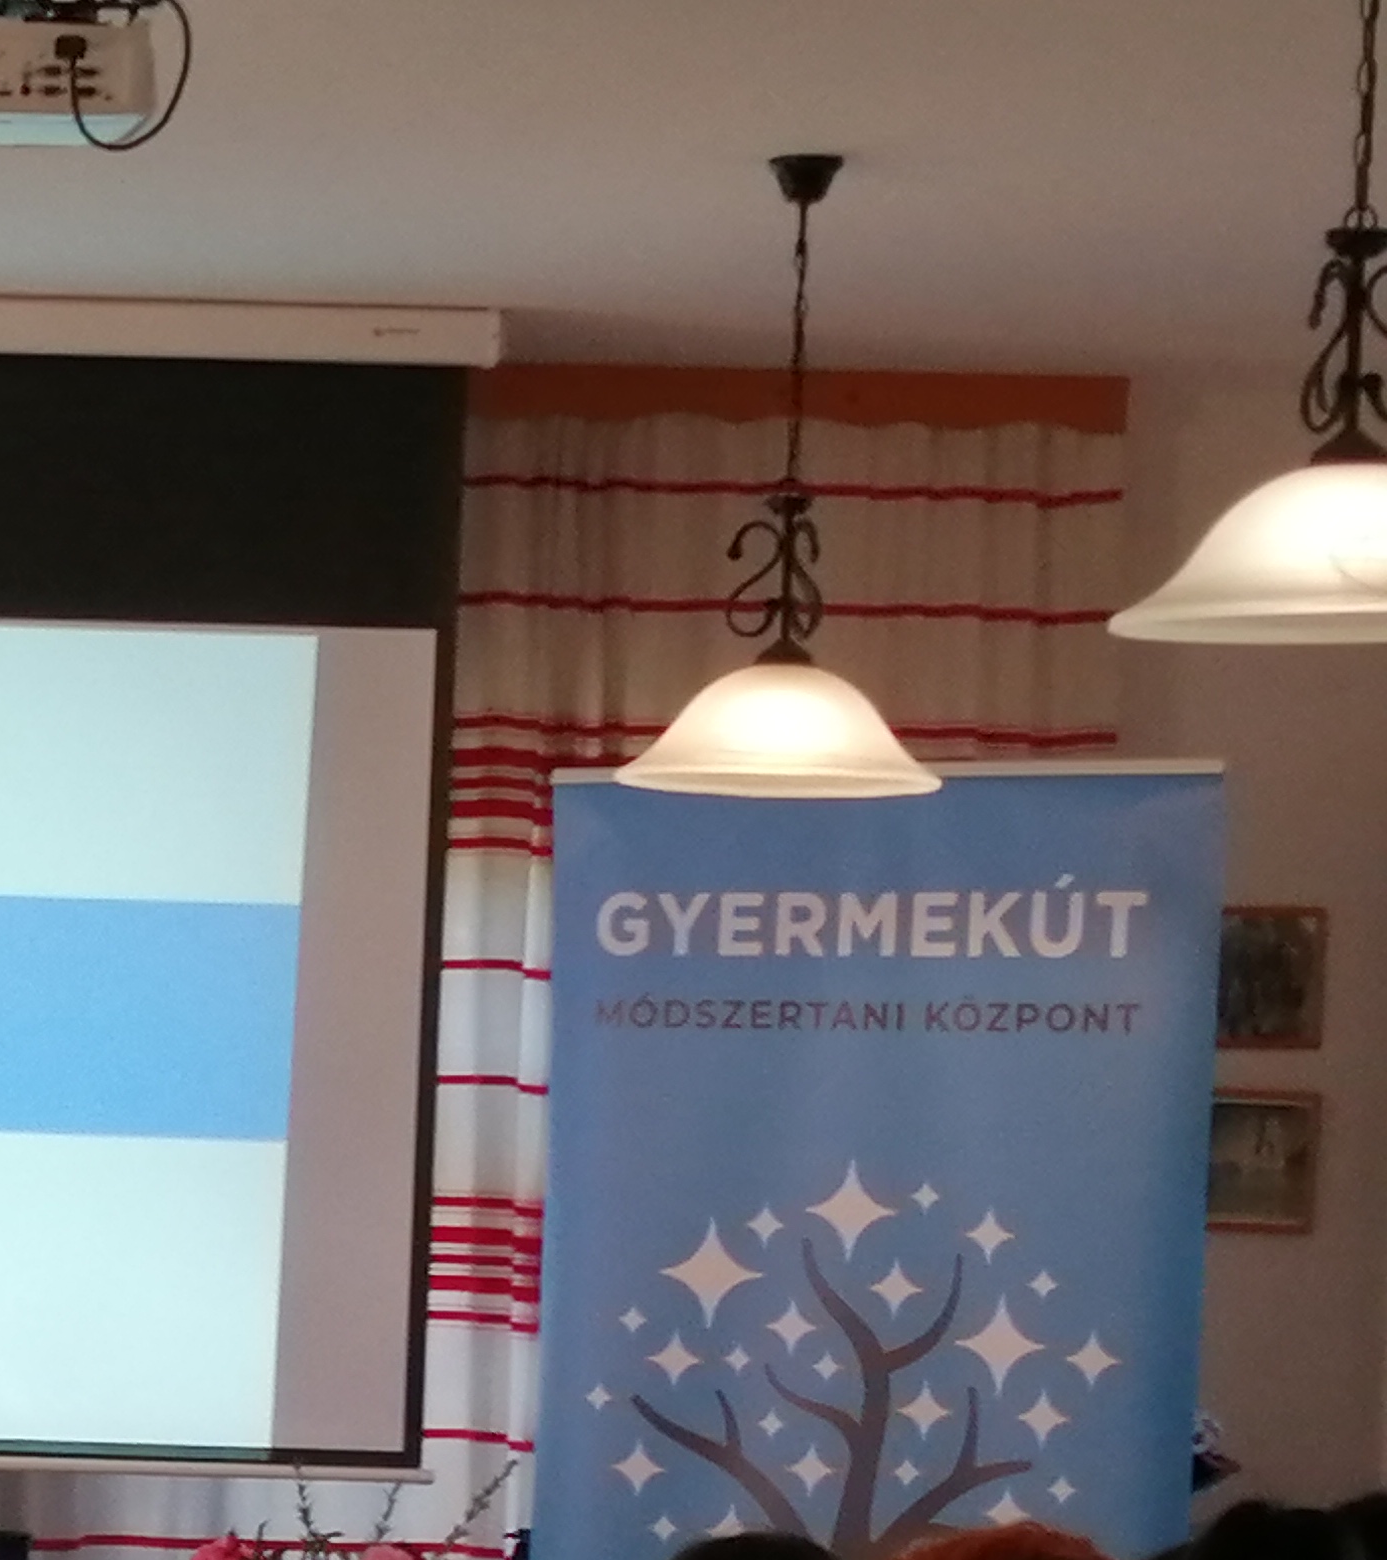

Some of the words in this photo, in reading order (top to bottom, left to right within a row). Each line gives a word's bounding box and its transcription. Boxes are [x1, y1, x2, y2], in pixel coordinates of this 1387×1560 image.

[596, 874, 1149, 959] GYERMEKÚT
[594, 993, 906, 1031] MÓDSZERTANI
[924, 997, 1143, 1036] KÖZPONT
